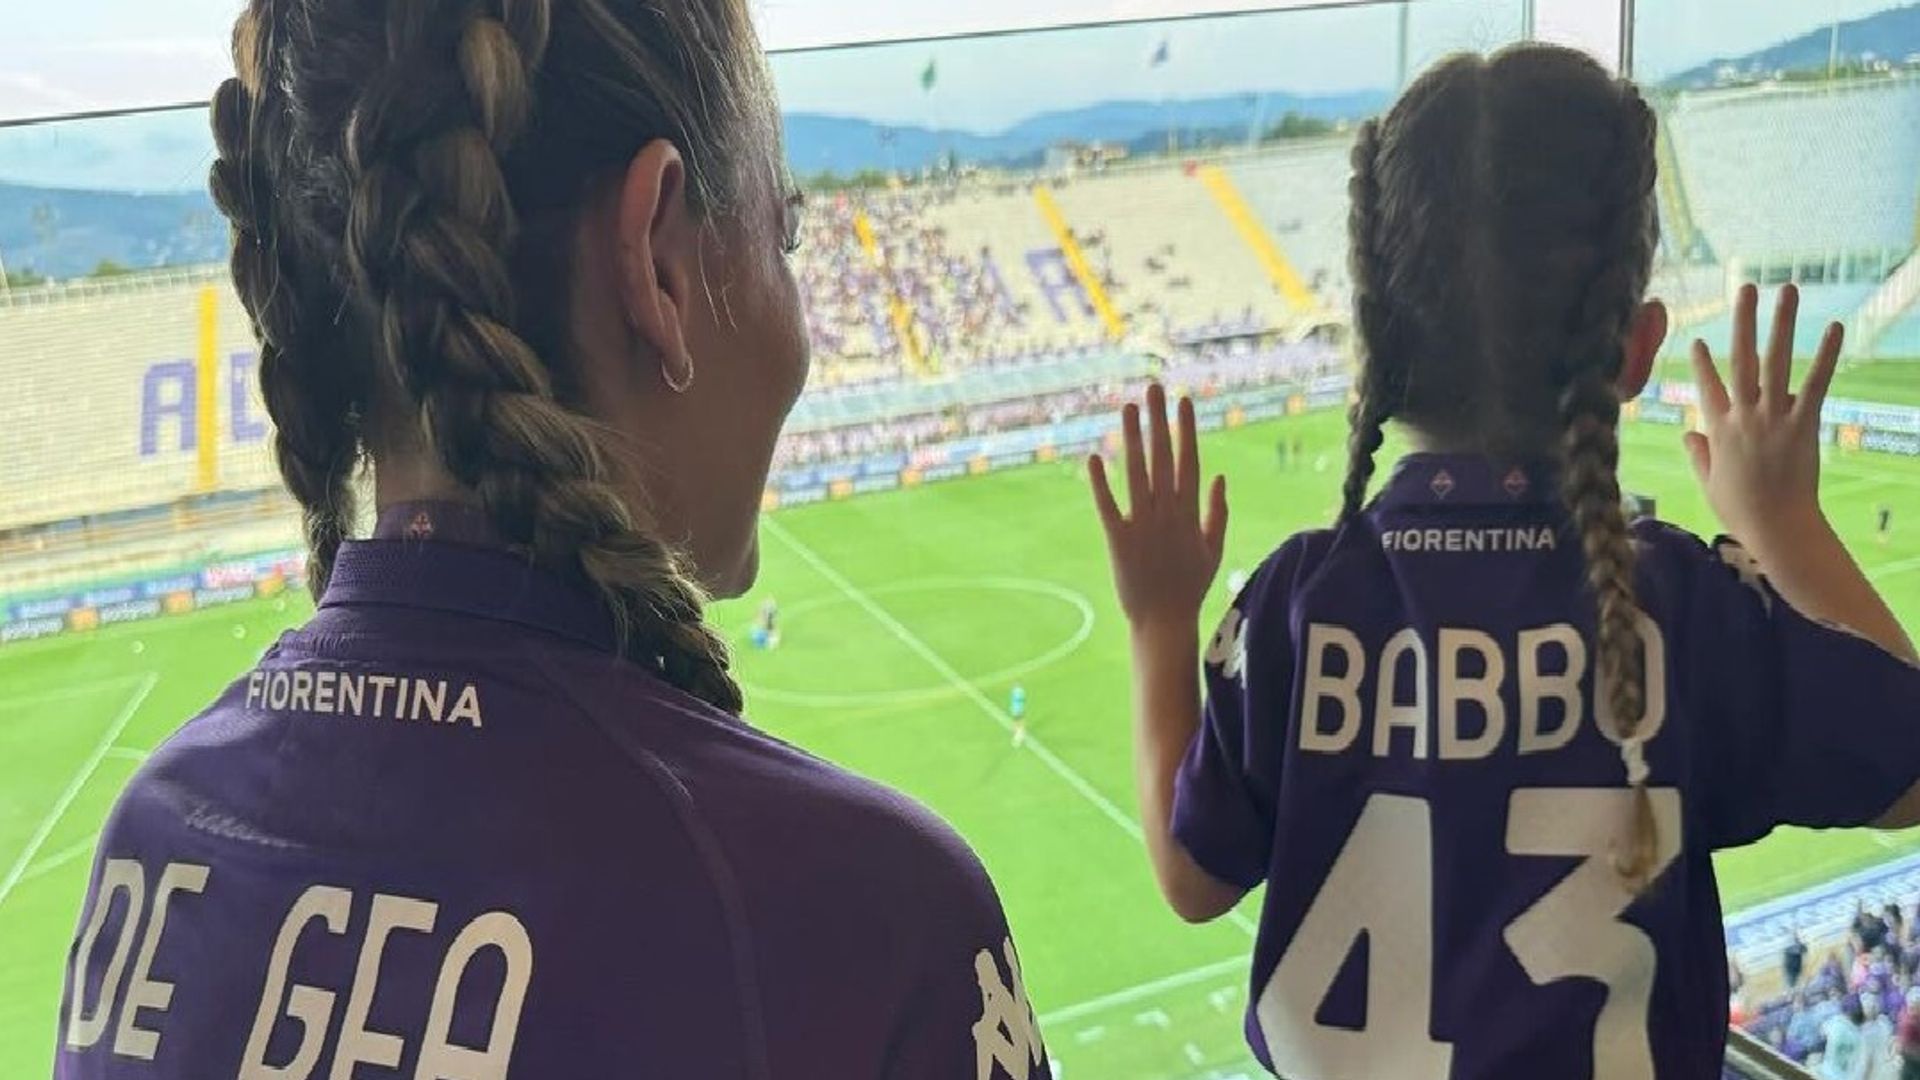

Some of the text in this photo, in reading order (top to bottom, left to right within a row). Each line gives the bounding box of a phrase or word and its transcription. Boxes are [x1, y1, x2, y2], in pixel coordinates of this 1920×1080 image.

[1381, 528, 1556, 551] FIORENTINA
[247, 671, 483, 727] FIORENTINA
[1299, 618, 1666, 760] BABBO
[67, 858, 534, 1080] DE GEA
[1257, 786, 1683, 1080] 43
